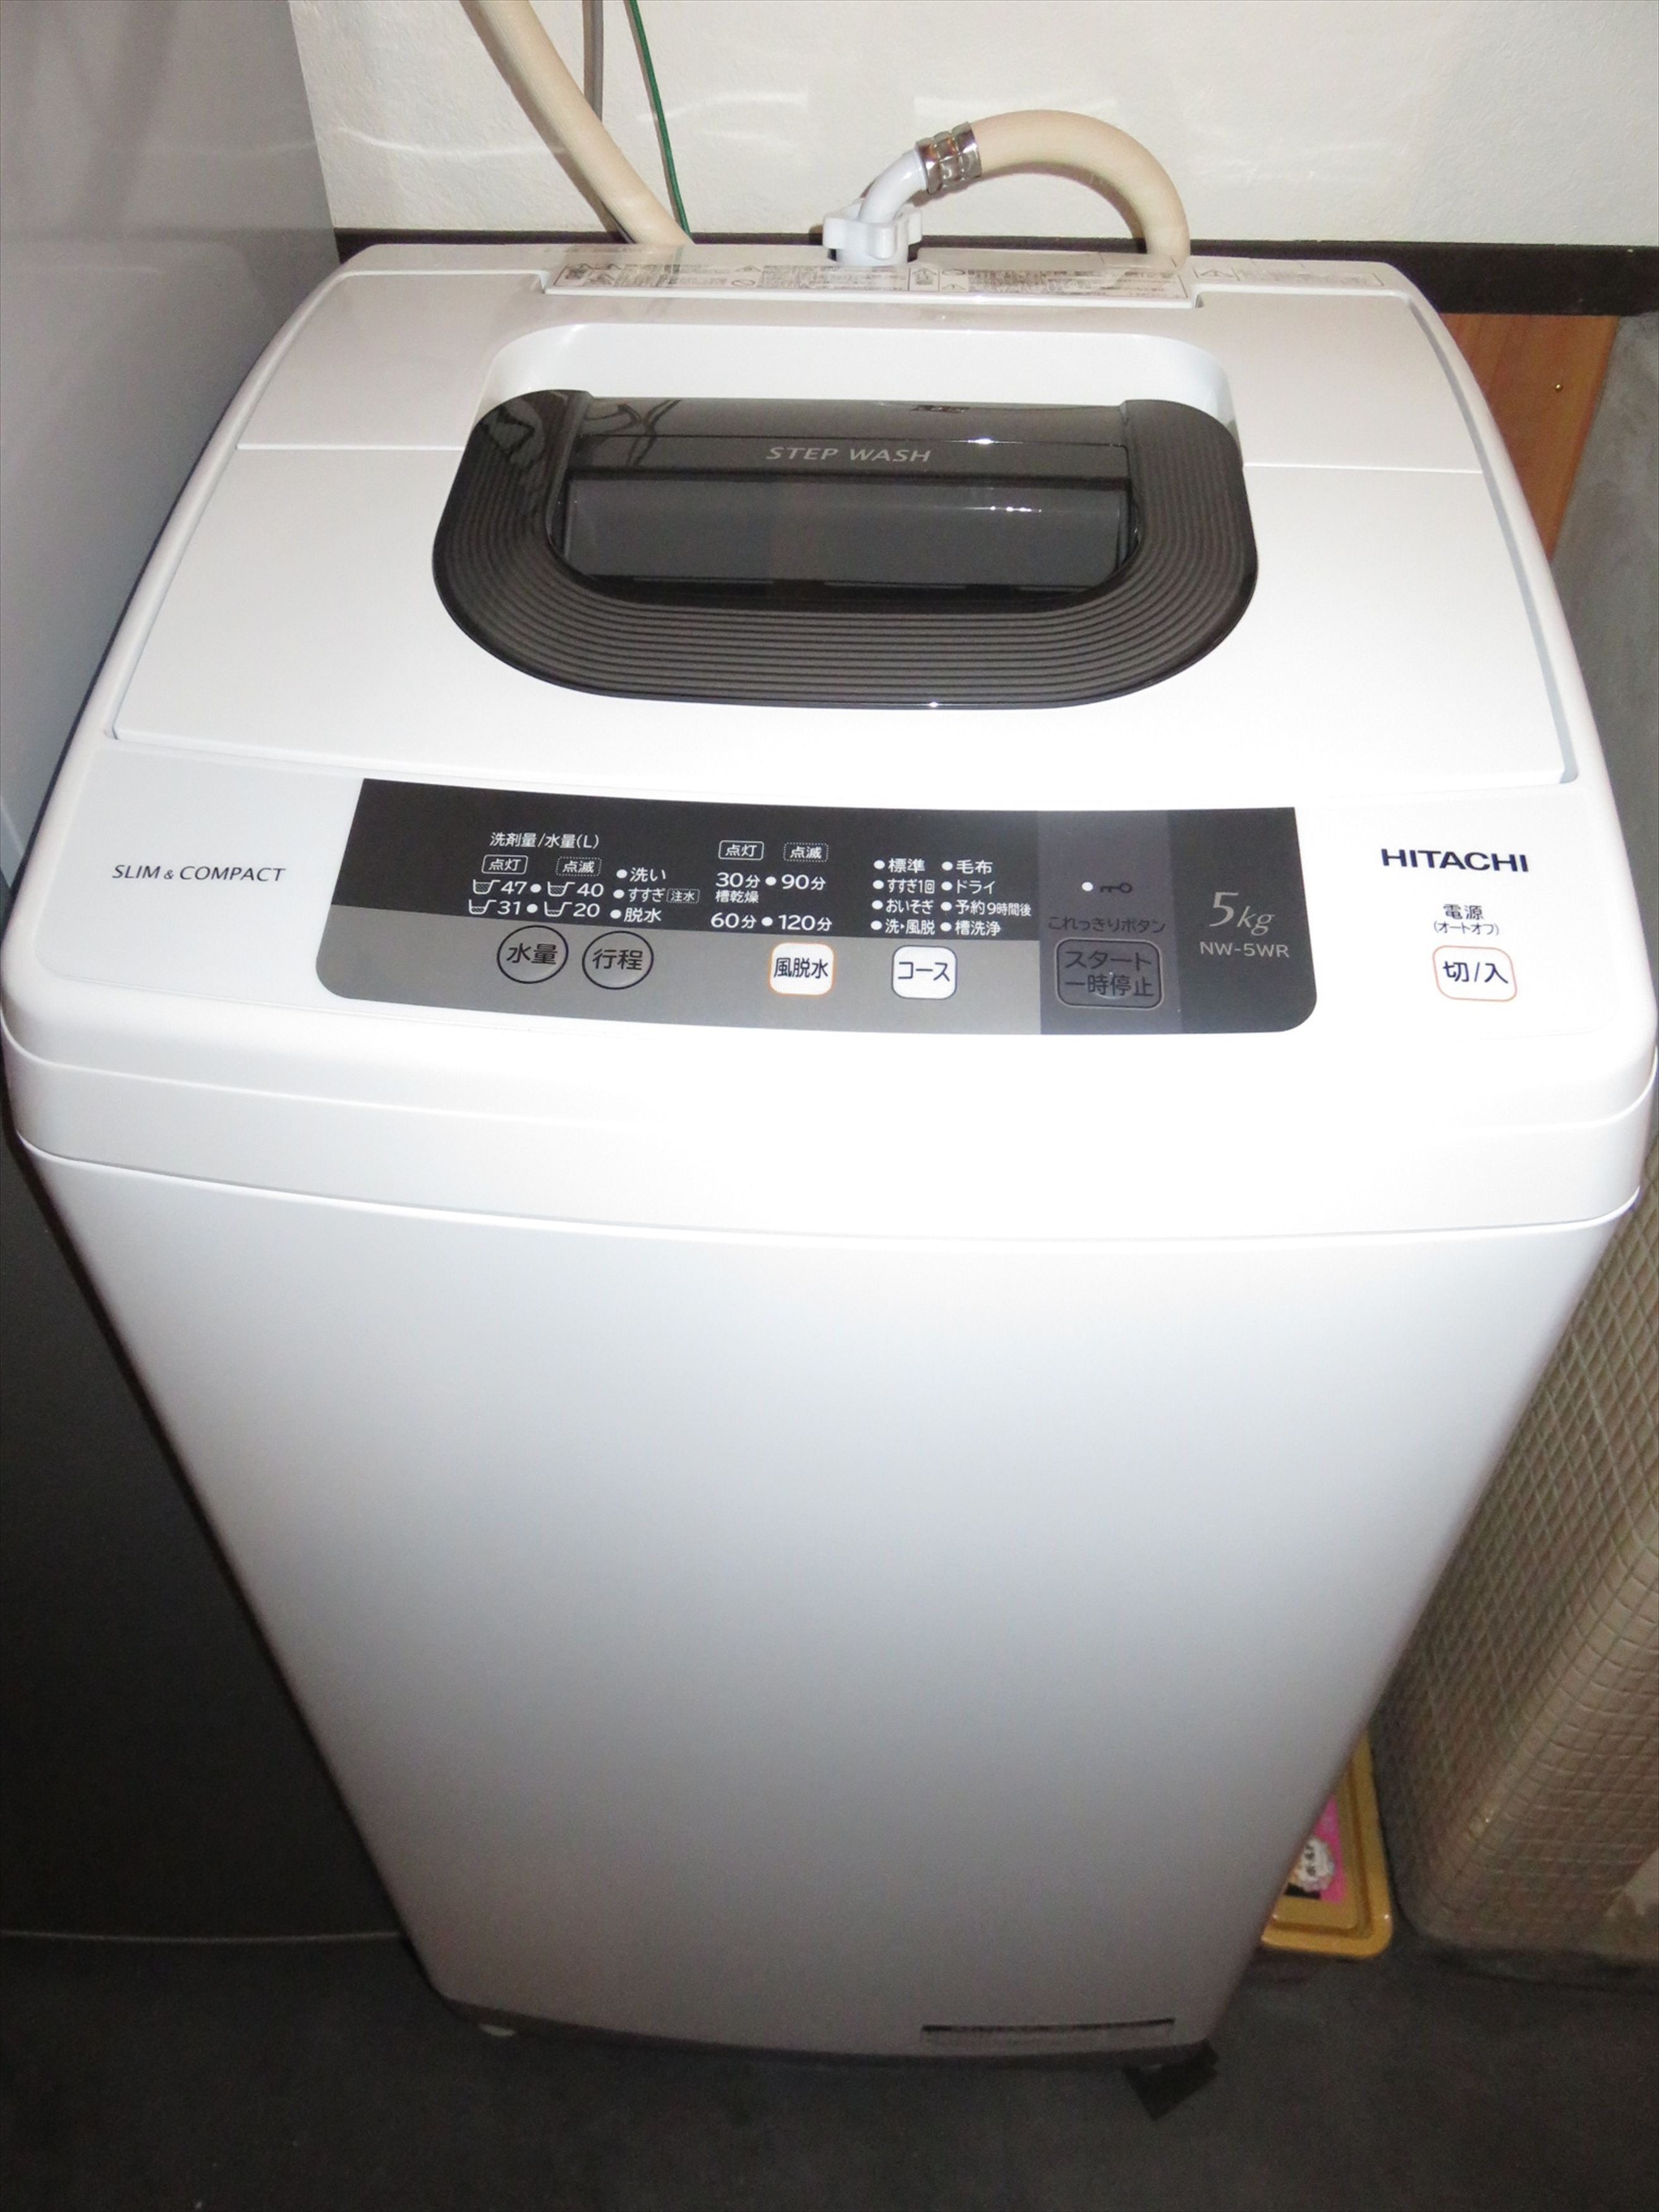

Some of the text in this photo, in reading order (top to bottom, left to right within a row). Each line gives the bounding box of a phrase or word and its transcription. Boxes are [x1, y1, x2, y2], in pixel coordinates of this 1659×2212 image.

[766, 447, 931, 462] STEP WASH
[725, 844, 757, 858] 点灯
[789, 846, 822, 859] 点滅
[489, 858, 521, 872] 点灯
[562, 860, 594, 874] 点滅
[887, 858, 993, 875] 標準 毛布
[1381, 849, 1529, 872] HITACHI
[112, 865, 286, 882] SLIM & COMPACT
[629, 867, 666, 882] 洗い
[715, 872, 826, 890] 30分 90分
[501, 881, 604, 897] 47 40
[887, 878, 995, 894] すすぎ1回 ドライ
[628, 888, 695, 902] すすぎ 注水
[715, 890, 759, 904] 槽乾燥
[497, 901, 600, 918] 31 20
[624, 907, 662, 923] 脱水
[885, 899, 933, 915] おいそぎ
[1443, 904, 1484, 920] 電源
[710, 913, 832, 932] 60分 120分
[954, 920, 1001, 937] 槽洗浄
[1048, 916, 1165, 934] これっきりボタン
[1433, 920, 1499, 935] (オートオフ)
[506, 943, 558, 966] 水量
[1200, 941, 1290, 958] NW-5WR
[592, 949, 643, 971] 行程
[774, 957, 829, 979] 風脱水
[1065, 950, 1152, 971] スタート
[897, 961, 950, 981] コース
[1442, 961, 1509, 984] 切/入
[1065, 973, 1154, 997] 一時停止
